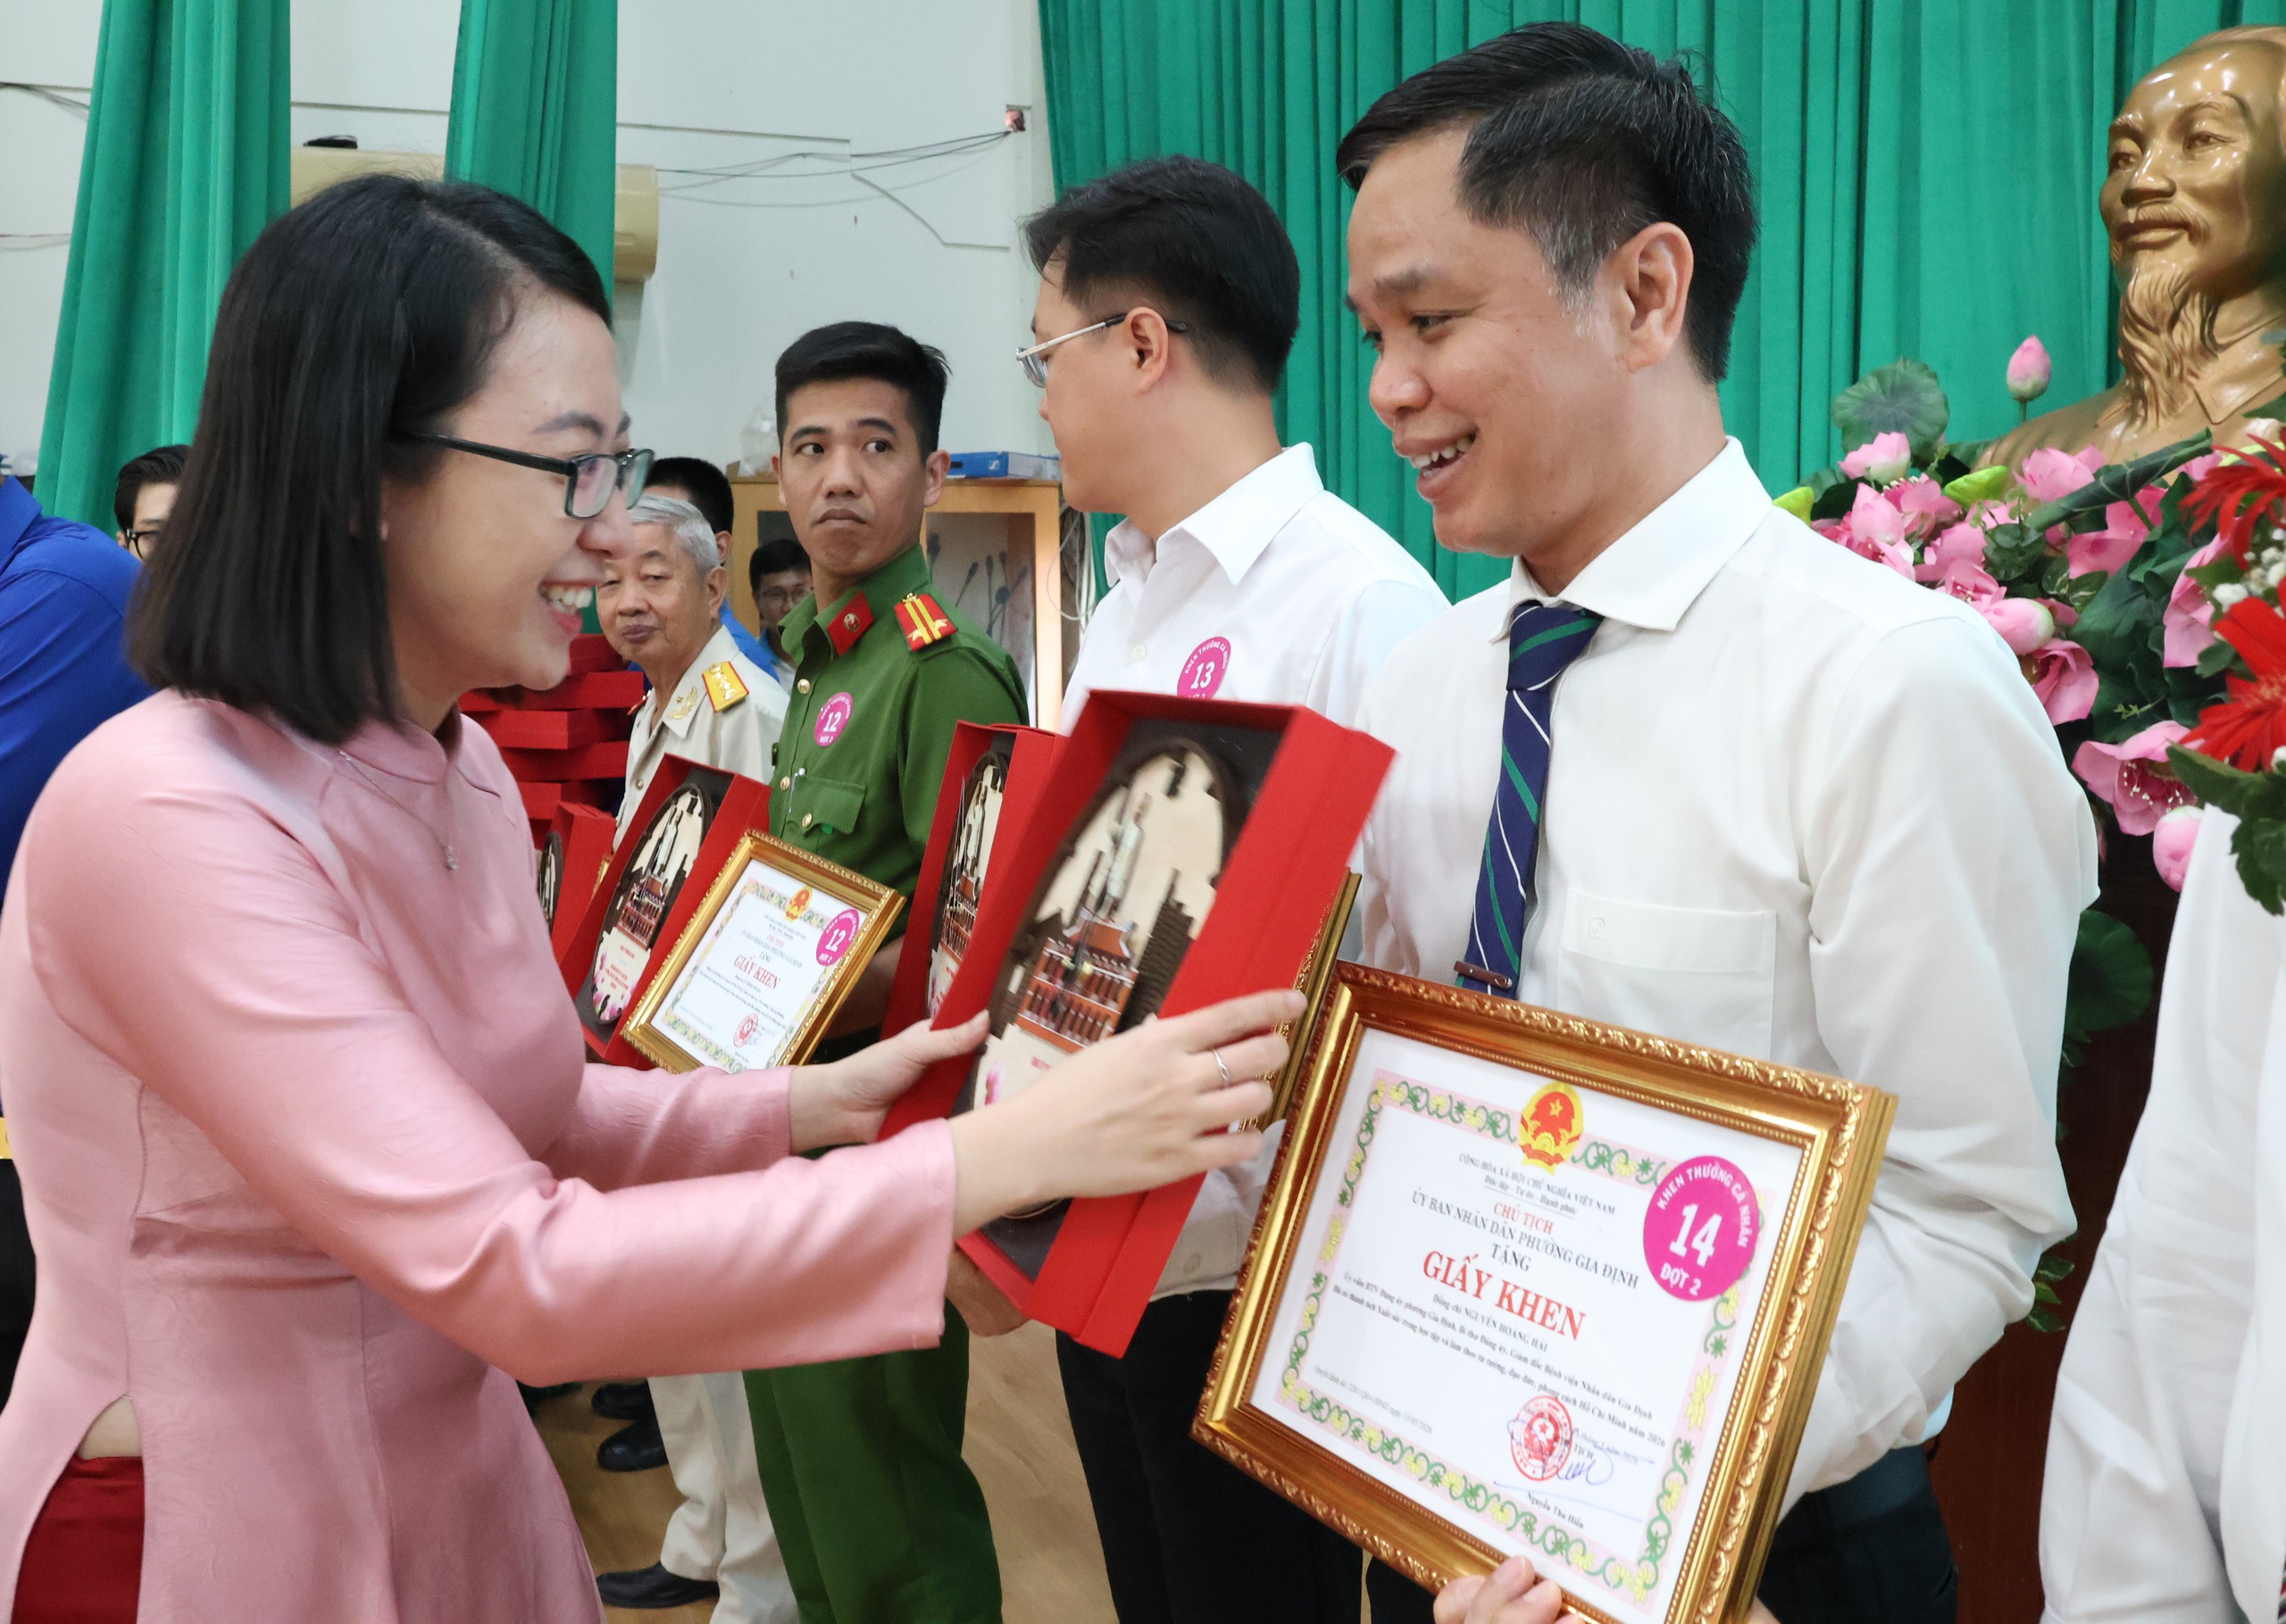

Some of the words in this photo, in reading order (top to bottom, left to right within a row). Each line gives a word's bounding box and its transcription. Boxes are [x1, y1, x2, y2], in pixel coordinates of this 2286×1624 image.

[1190, 661, 1215, 689] 13
[823, 711, 842, 732] 12
[825, 929, 847, 953] 12
[733, 954, 757, 975] GIẤY
[753, 966, 780, 989] KHEN
[1493, 1202, 1521, 1221] CHỦ
[1523, 1212, 1554, 1235] TỊCH
[1596, 1201, 1615, 1214] NAM
[1656, 1174, 1685, 1210] KHEN
[1737, 1205, 1753, 1248] NHÂN
[1412, 1187, 1428, 1207] ỦY
[1429, 1196, 1453, 1216] BAN
[1454, 1206, 1489, 1229] NHÂN
[1489, 1220, 1515, 1240] DÂN
[1518, 1231, 1573, 1262] PHƯỜNG
[1575, 1254, 1598, 1274] GIA
[1602, 1263, 1639, 1288] ĐỊNH
[1669, 1203, 1723, 1268] 14
[1491, 1243, 1531, 1271] TẶNG
[1660, 1262, 1689, 1288] ĐỢT
[1689, 1278, 1702, 1295] 2
[1422, 1251, 1492, 1299] GIẤY
[1495, 1279, 1586, 1340] KHEN
[1581, 1380, 1600, 1396] Nhân
[1601, 1391, 1616, 1404] dân
[1617, 1397, 1631, 1411] Gia
[1633, 1404, 1652, 1420] Định
[1560, 1395, 1577, 1406] cách
[1579, 1400, 1590, 1412] Hồ
[1591, 1406, 1605, 1420] Chí
[1607, 1412, 1627, 1429] Minh
[1628, 1425, 1645, 1438] năm
[1647, 1431, 1665, 1447] 2026
[1573, 1443, 1594, 1460] TỊCH
[1527, 1490, 1551, 1512] Nguyễn
